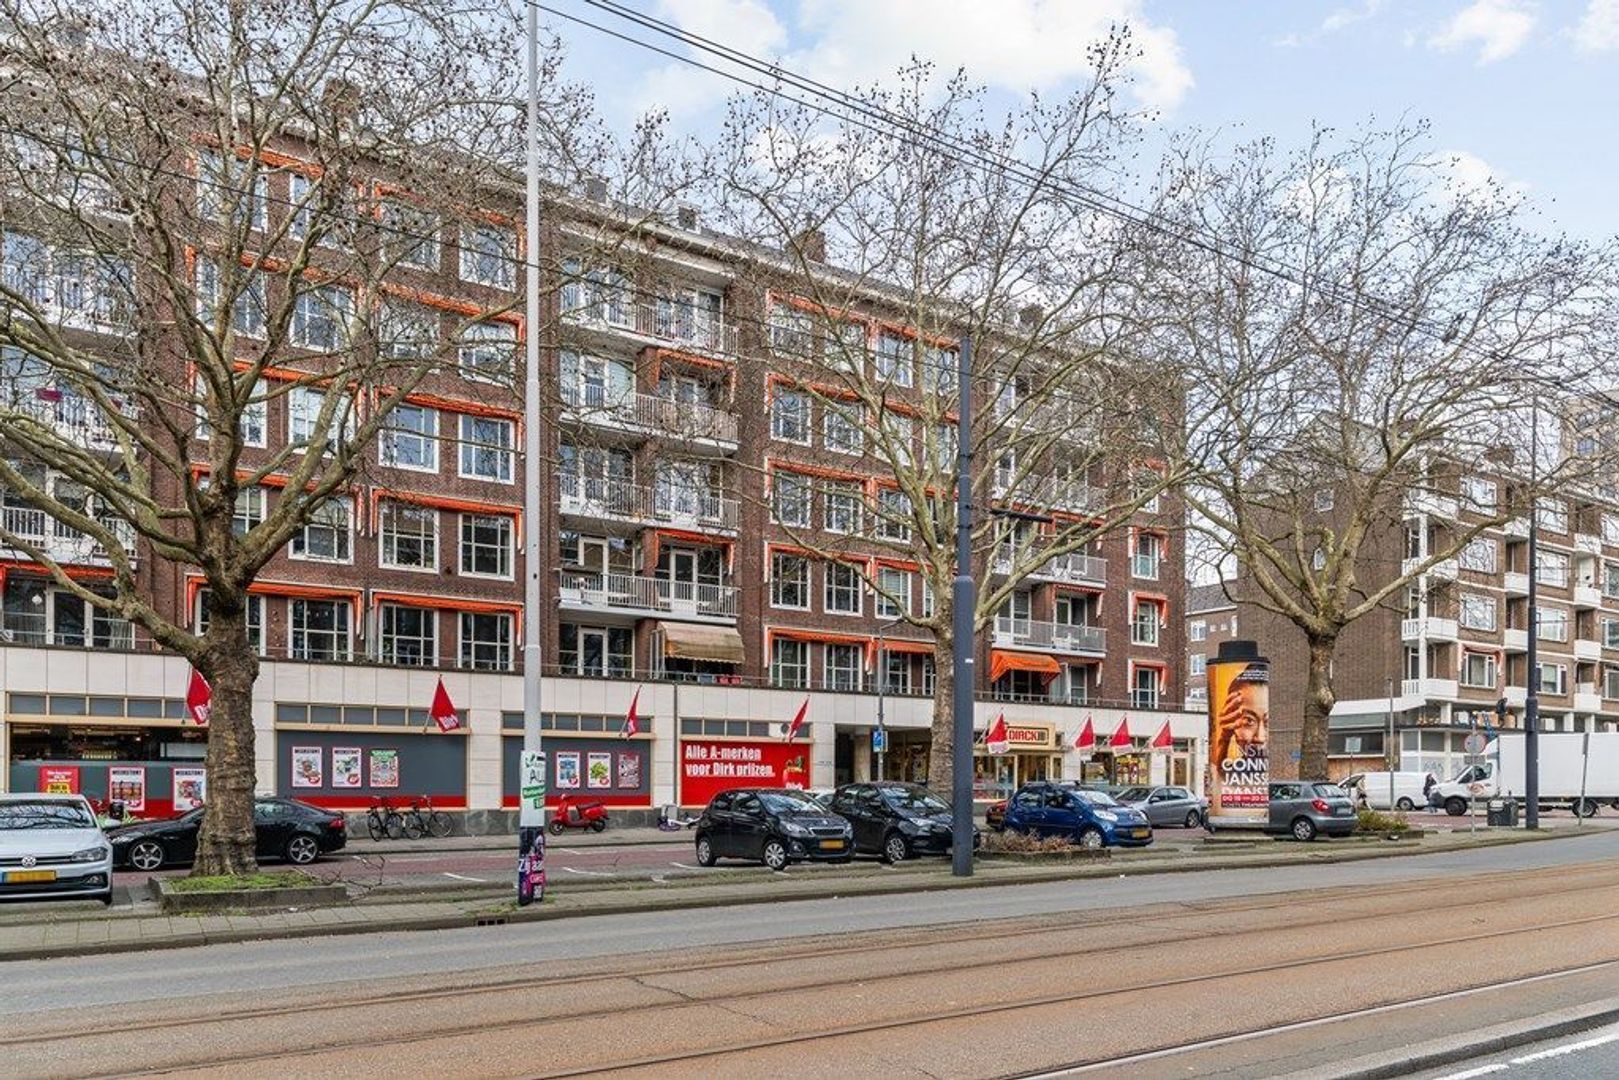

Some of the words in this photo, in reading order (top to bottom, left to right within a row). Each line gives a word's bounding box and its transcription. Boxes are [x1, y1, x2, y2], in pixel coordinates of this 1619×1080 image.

[685, 745, 708, 759] Alle
[710, 745, 762, 761] A-merken
[685, 763, 711, 777] voor
[713, 762, 735, 777] Dirk
